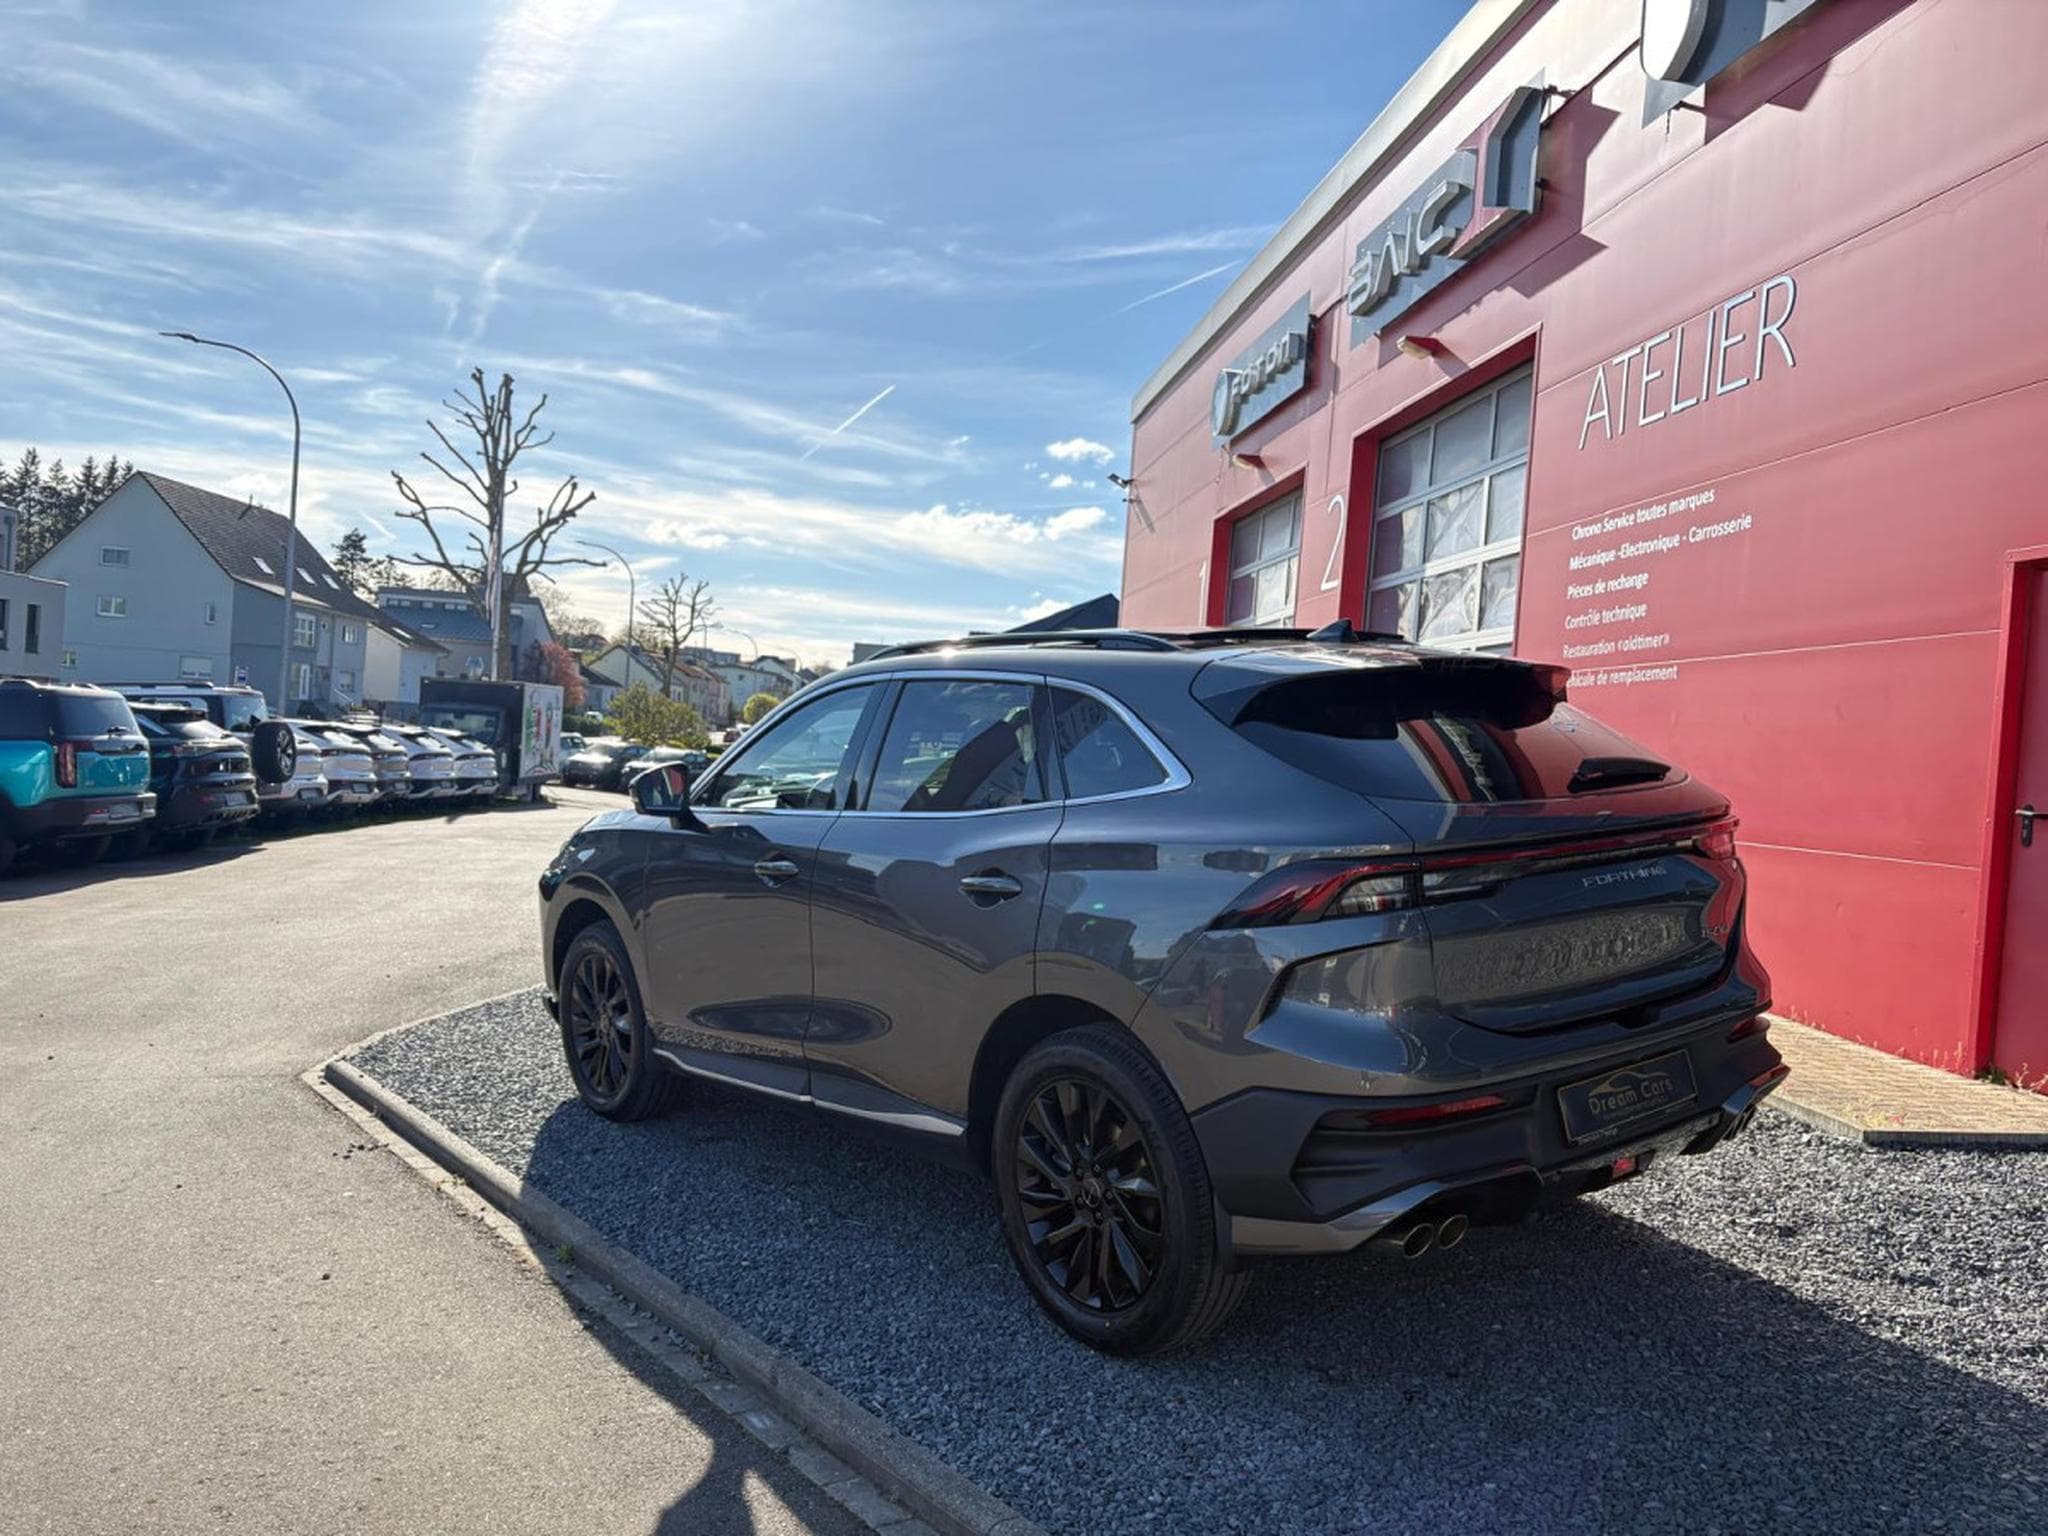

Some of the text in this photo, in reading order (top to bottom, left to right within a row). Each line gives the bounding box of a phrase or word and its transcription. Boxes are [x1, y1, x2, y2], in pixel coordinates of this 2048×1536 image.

[1578, 274, 1797, 451] ATELIER
[1572, 489, 1716, 541] Chrono Service toutes marques
[1320, 494, 1345, 592] 2
[1569, 547, 1616, 570] Mécanique
[1688, 513, 1753, 544] Carrosserie
[1594, 578, 1607, 596] de
[1607, 571, 1650, 592] rechange
[1564, 602, 1648, 630] Contrôle technique
[1562, 638, 1616, 659] Restauration
[1596, 669, 1608, 686] de
[1609, 664, 1679, 687] remplacement
[1588, 1087, 1638, 1115] Dream
[1640, 1077, 1674, 1098] Cars
